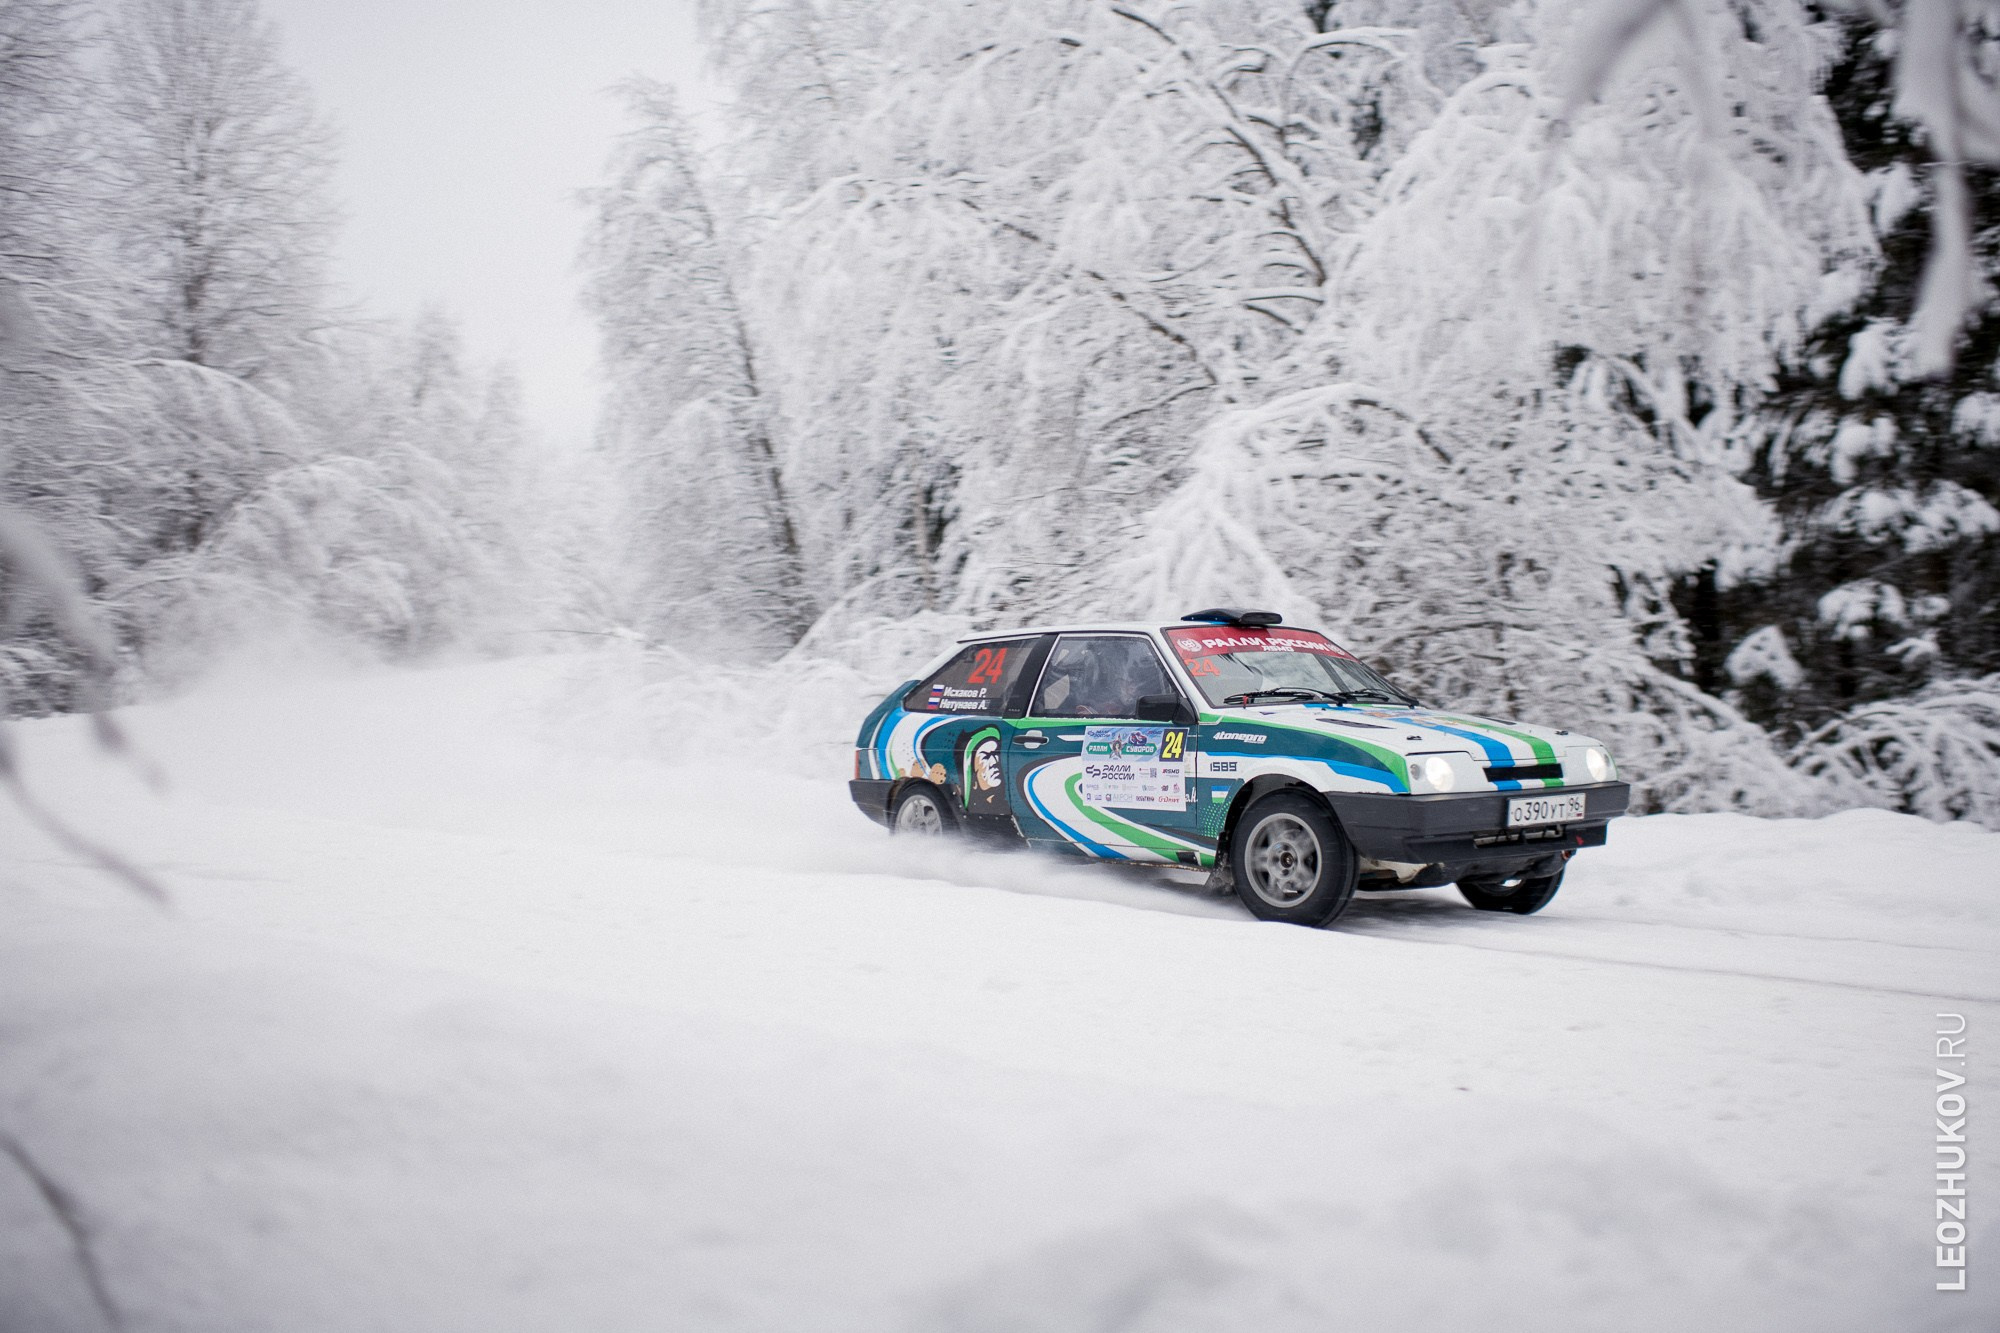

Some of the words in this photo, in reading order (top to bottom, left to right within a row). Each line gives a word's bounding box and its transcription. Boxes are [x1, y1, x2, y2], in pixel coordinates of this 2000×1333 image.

[1202, 637, 1266, 648] РАЛЛИ
[1265, 638, 1330, 652] РОССИИ
[967, 647, 1008, 684] 24
[1184, 658, 1220, 677] 24
[979, 687, 988, 698] Р.
[978, 699, 988, 710] А.
[1126, 745, 1155, 753] СУВОРОВ
[1161, 731, 1184, 759] 24
[1102, 764, 1131, 772] РАЛЛИ
[1101, 772, 1135, 780] РОССИИ
[1568, 797, 1580, 811] 96
